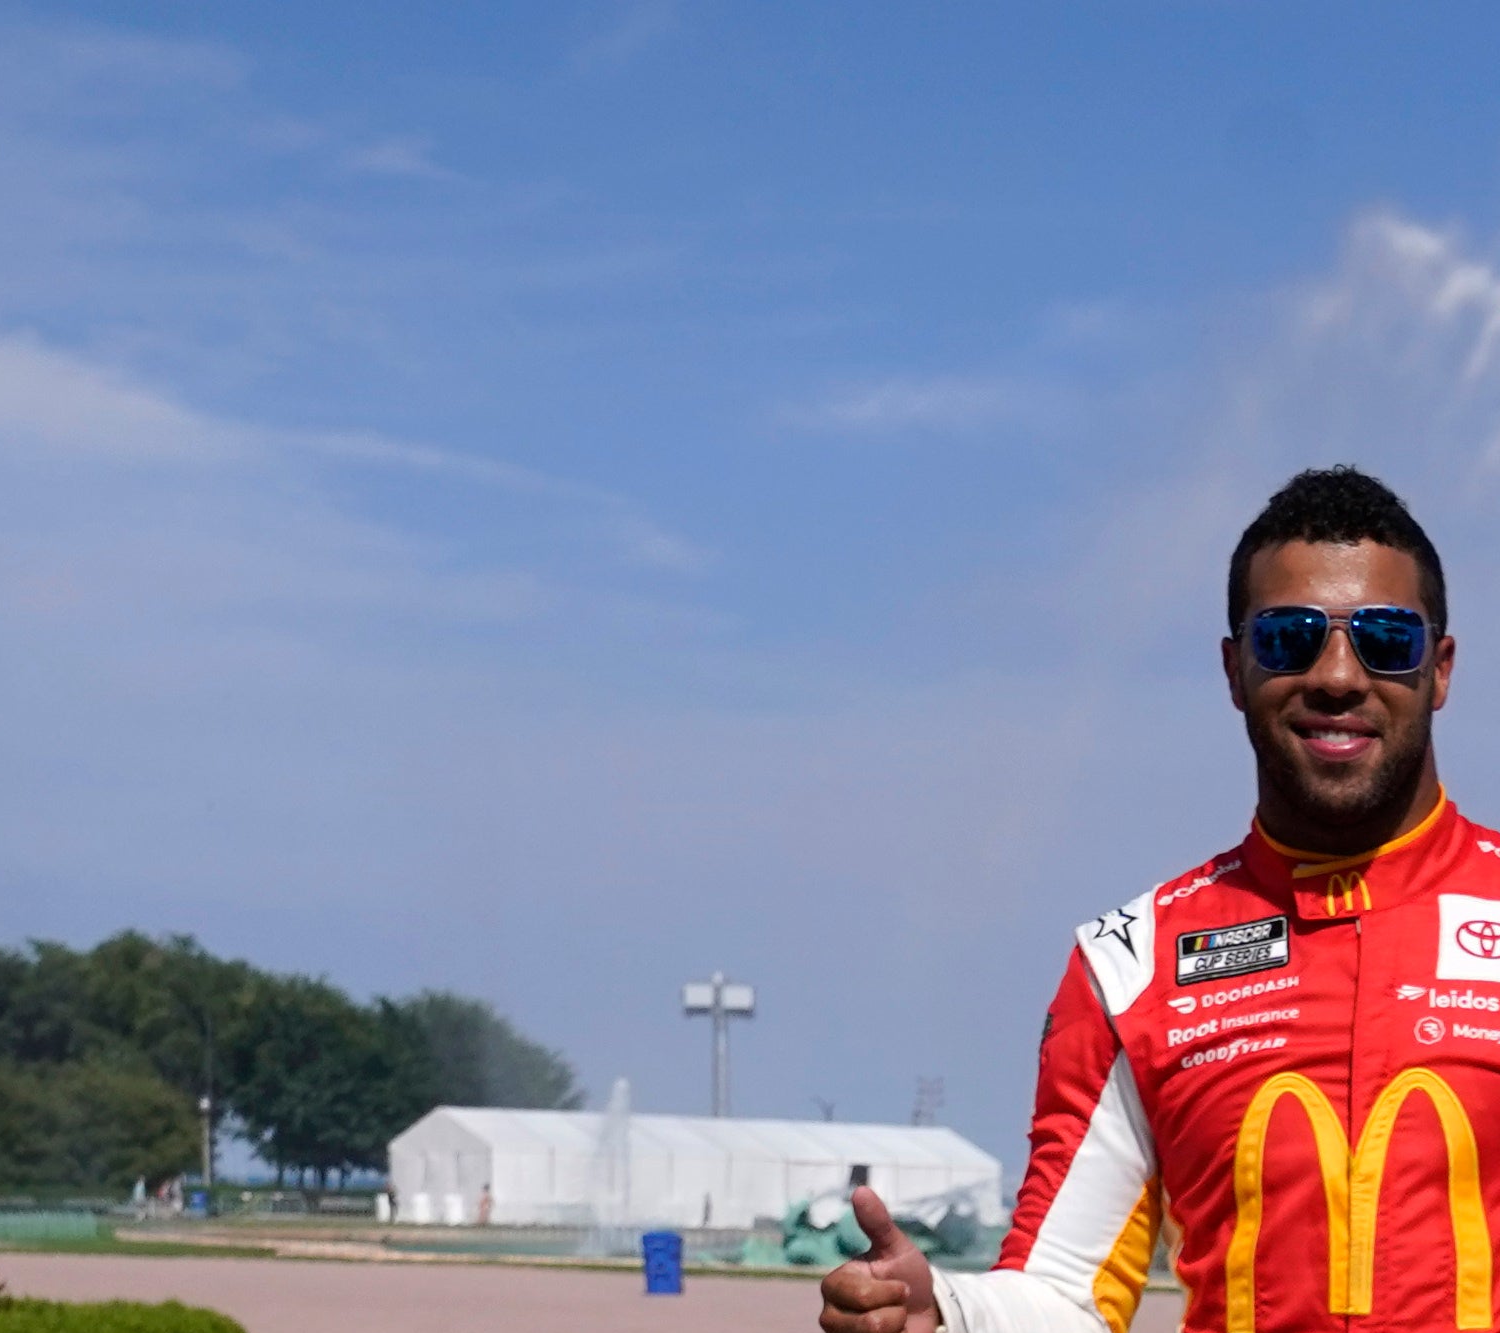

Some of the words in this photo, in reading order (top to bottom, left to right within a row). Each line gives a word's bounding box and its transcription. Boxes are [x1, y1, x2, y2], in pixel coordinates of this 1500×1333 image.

[1213, 923, 1273, 948] NASCAR
[1194, 954, 1224, 972] CUP
[1223, 945, 1273, 967] SERIES
[1201, 976, 1300, 1009] DOORDASH
[1428, 987, 1500, 1012] leidos
[1166, 1018, 1219, 1048] Root
[1220, 1008, 1301, 1031] Insurance
